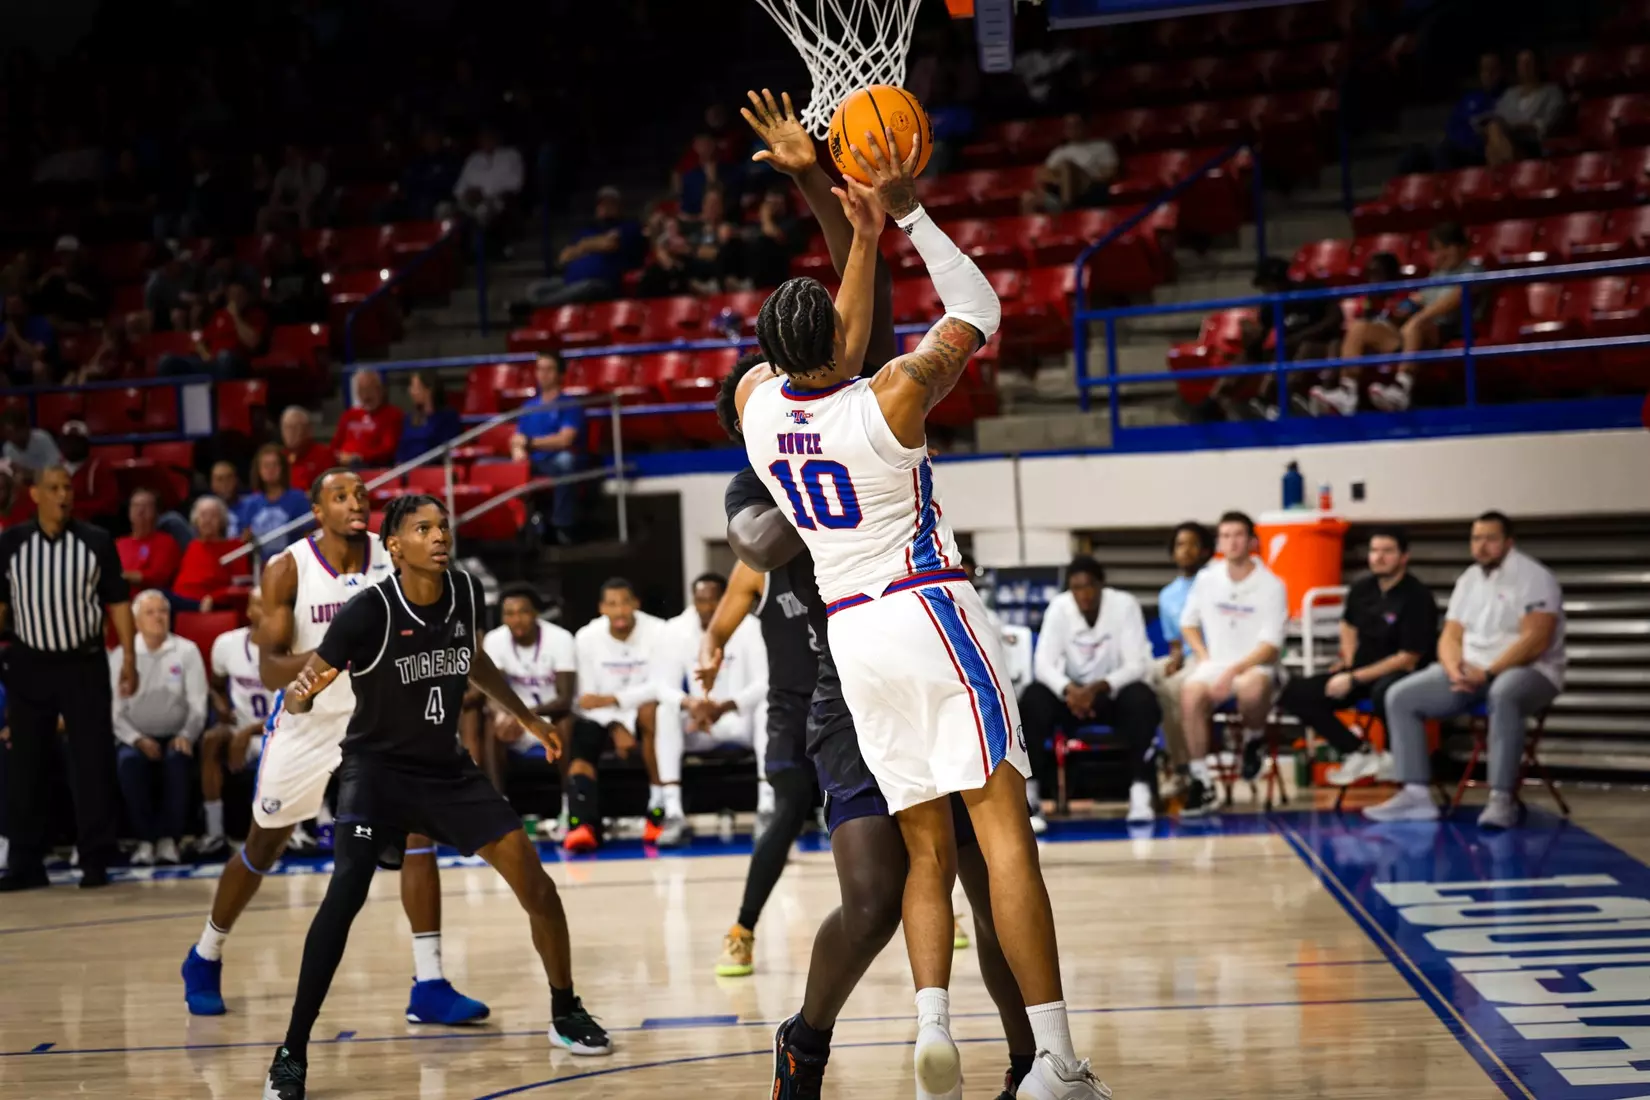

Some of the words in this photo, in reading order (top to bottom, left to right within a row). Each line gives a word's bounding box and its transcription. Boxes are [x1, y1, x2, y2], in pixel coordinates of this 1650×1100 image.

[768, 459, 863, 531] 10
[776, 591, 808, 619] TI
[395, 646, 472, 685] TIGERS
[424, 686, 445, 725] 4
